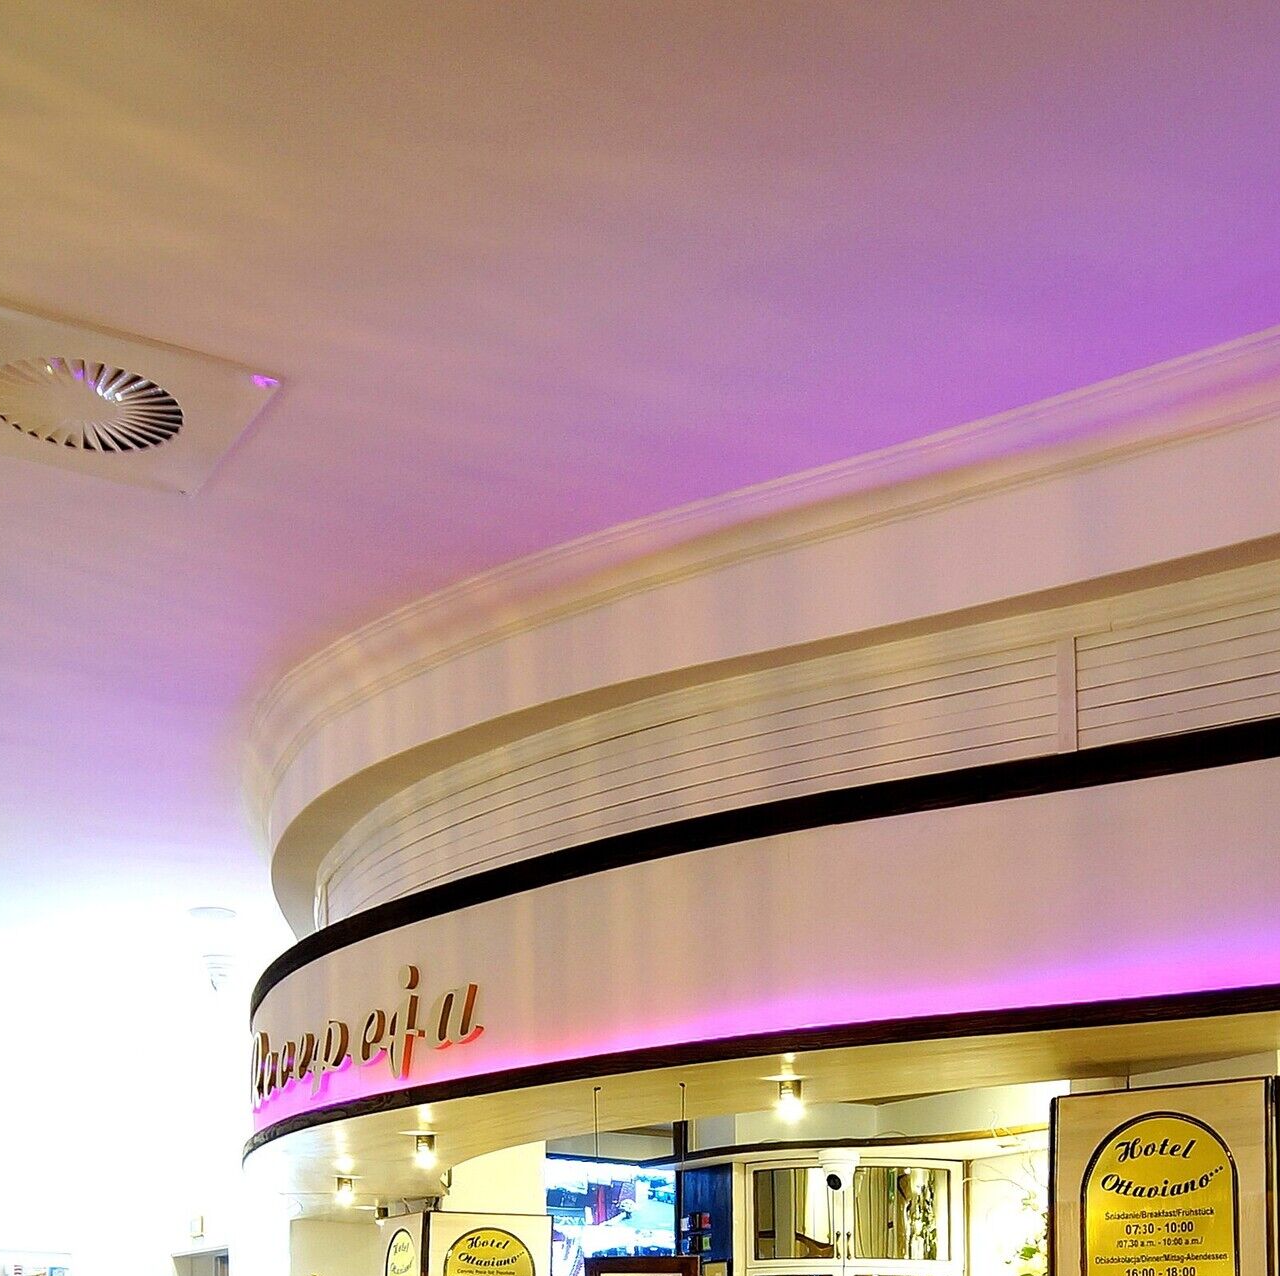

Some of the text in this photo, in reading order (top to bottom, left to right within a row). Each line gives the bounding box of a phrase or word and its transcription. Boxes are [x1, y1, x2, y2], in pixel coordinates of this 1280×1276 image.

[1115, 1137, 1197, 1163] Hotel
[1101, 1172, 1213, 1198] Ottaviano
[1125, 1223, 1154, 1235] 07:30
[1164, 1221, 1194, 1233] 10:00
[467, 1235, 510, 1251] Hotel
